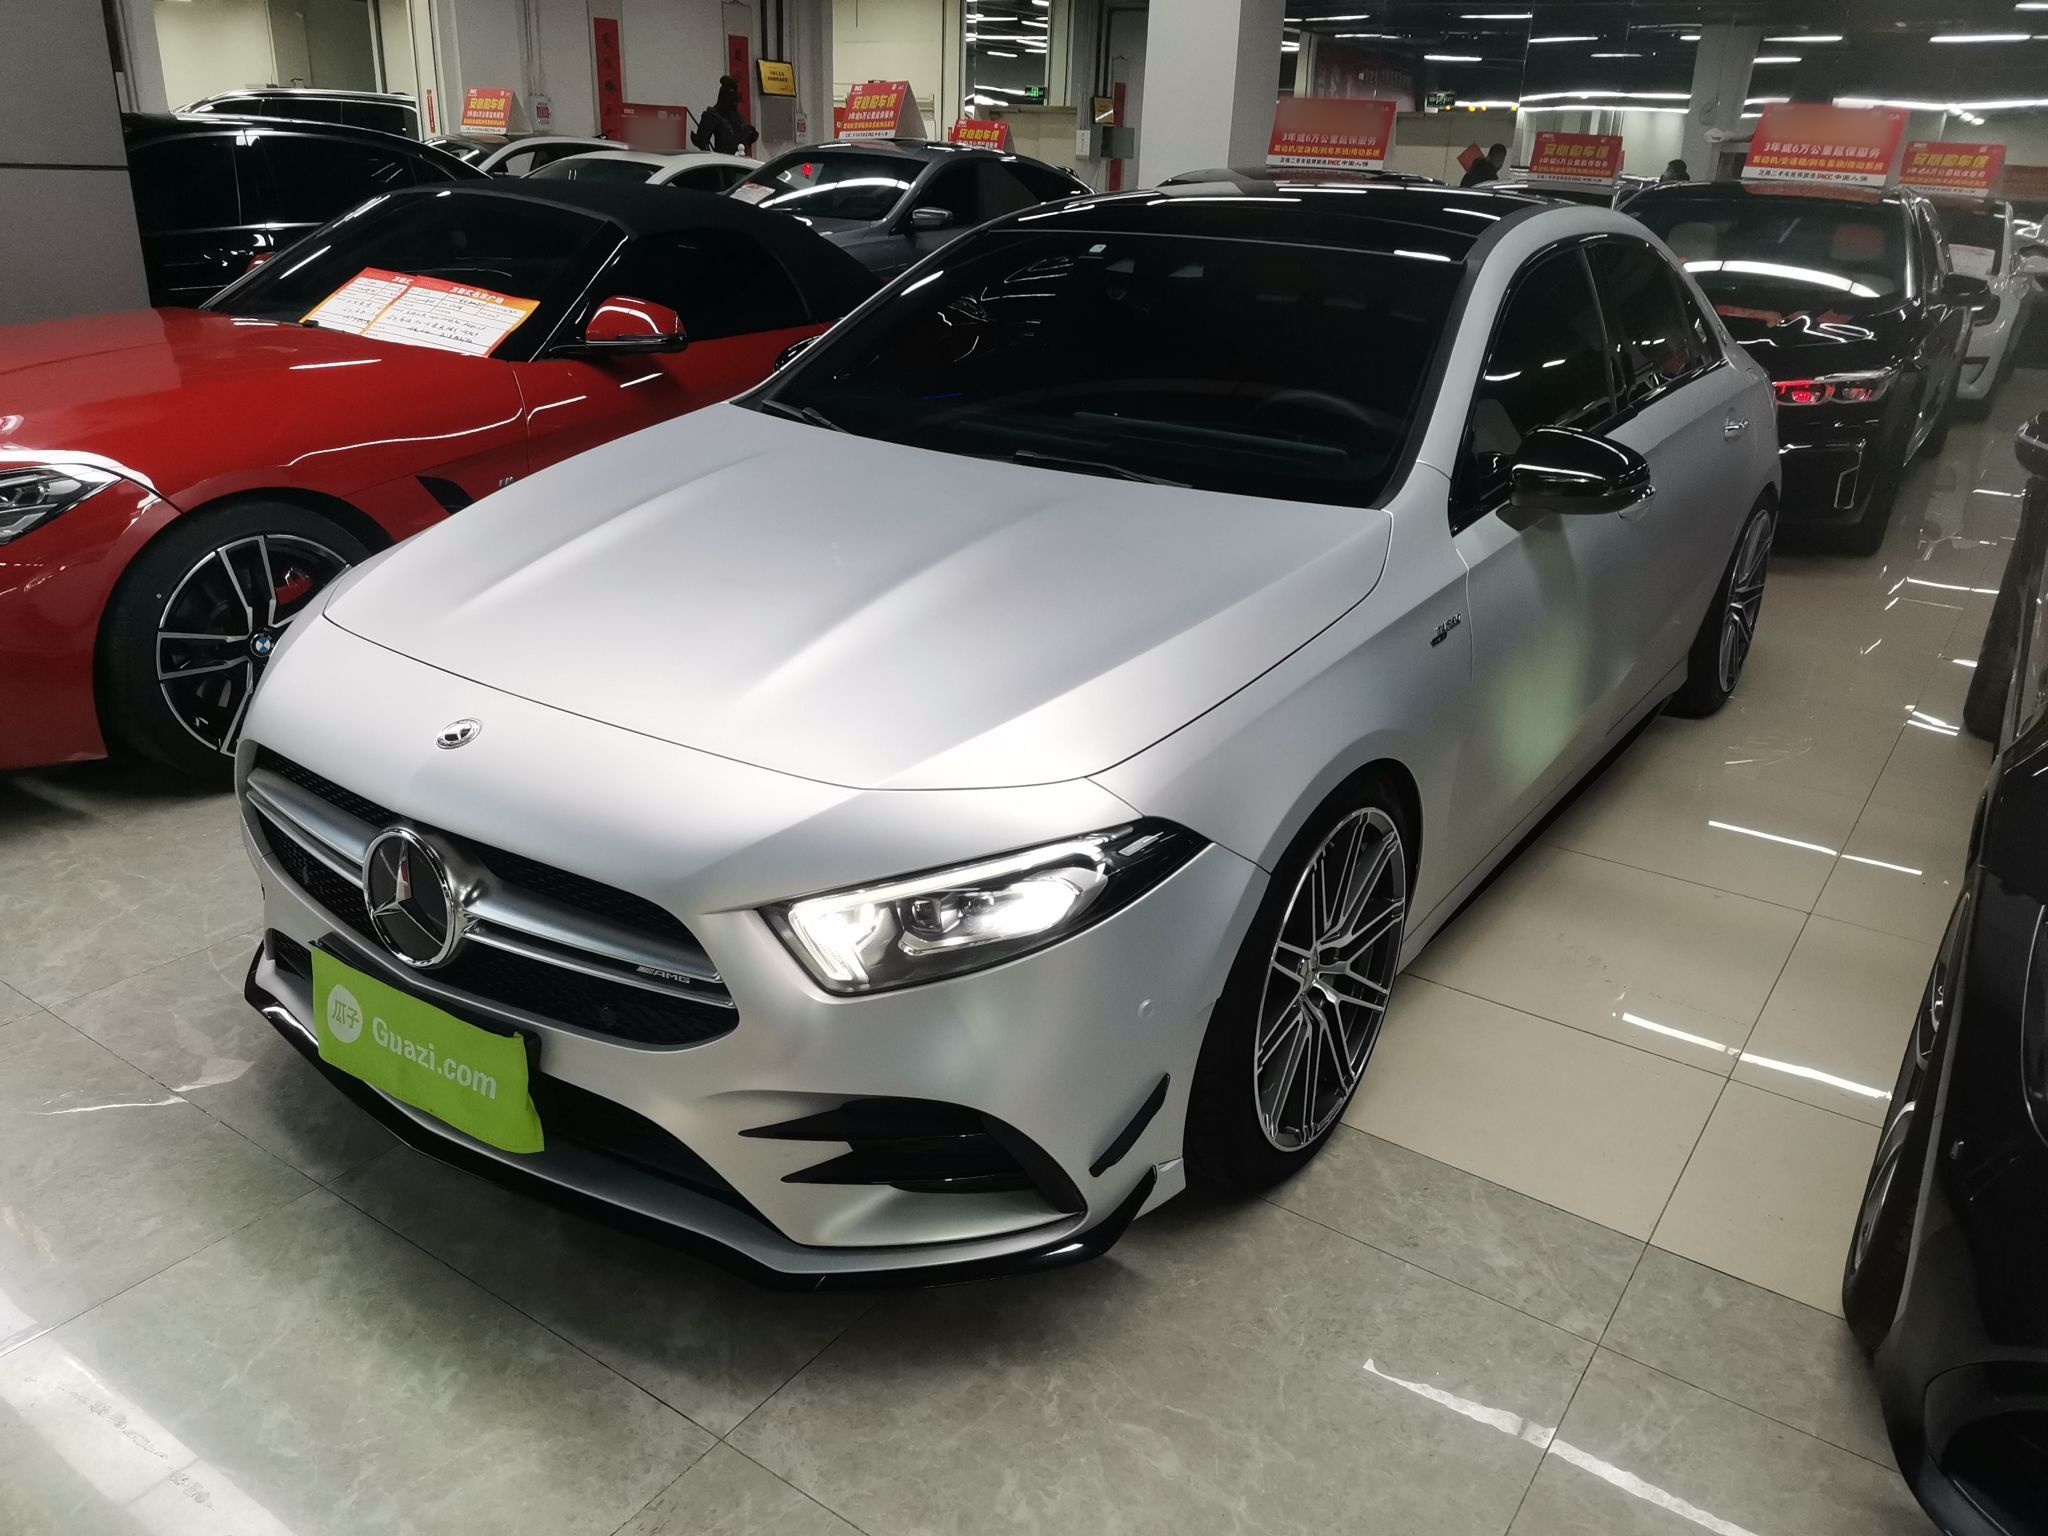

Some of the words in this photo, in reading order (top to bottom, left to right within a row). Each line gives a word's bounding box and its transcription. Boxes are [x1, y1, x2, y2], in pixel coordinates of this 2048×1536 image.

[1282, 132, 1377, 146] 3年或6万公里延保服务
[1764, 142, 1881, 159] 3年或6万公里延保服务
[653, 970, 690, 985] AMG
[331, 999, 361, 1030] 瓜子
[371, 1016, 498, 1100] Guazi.com
